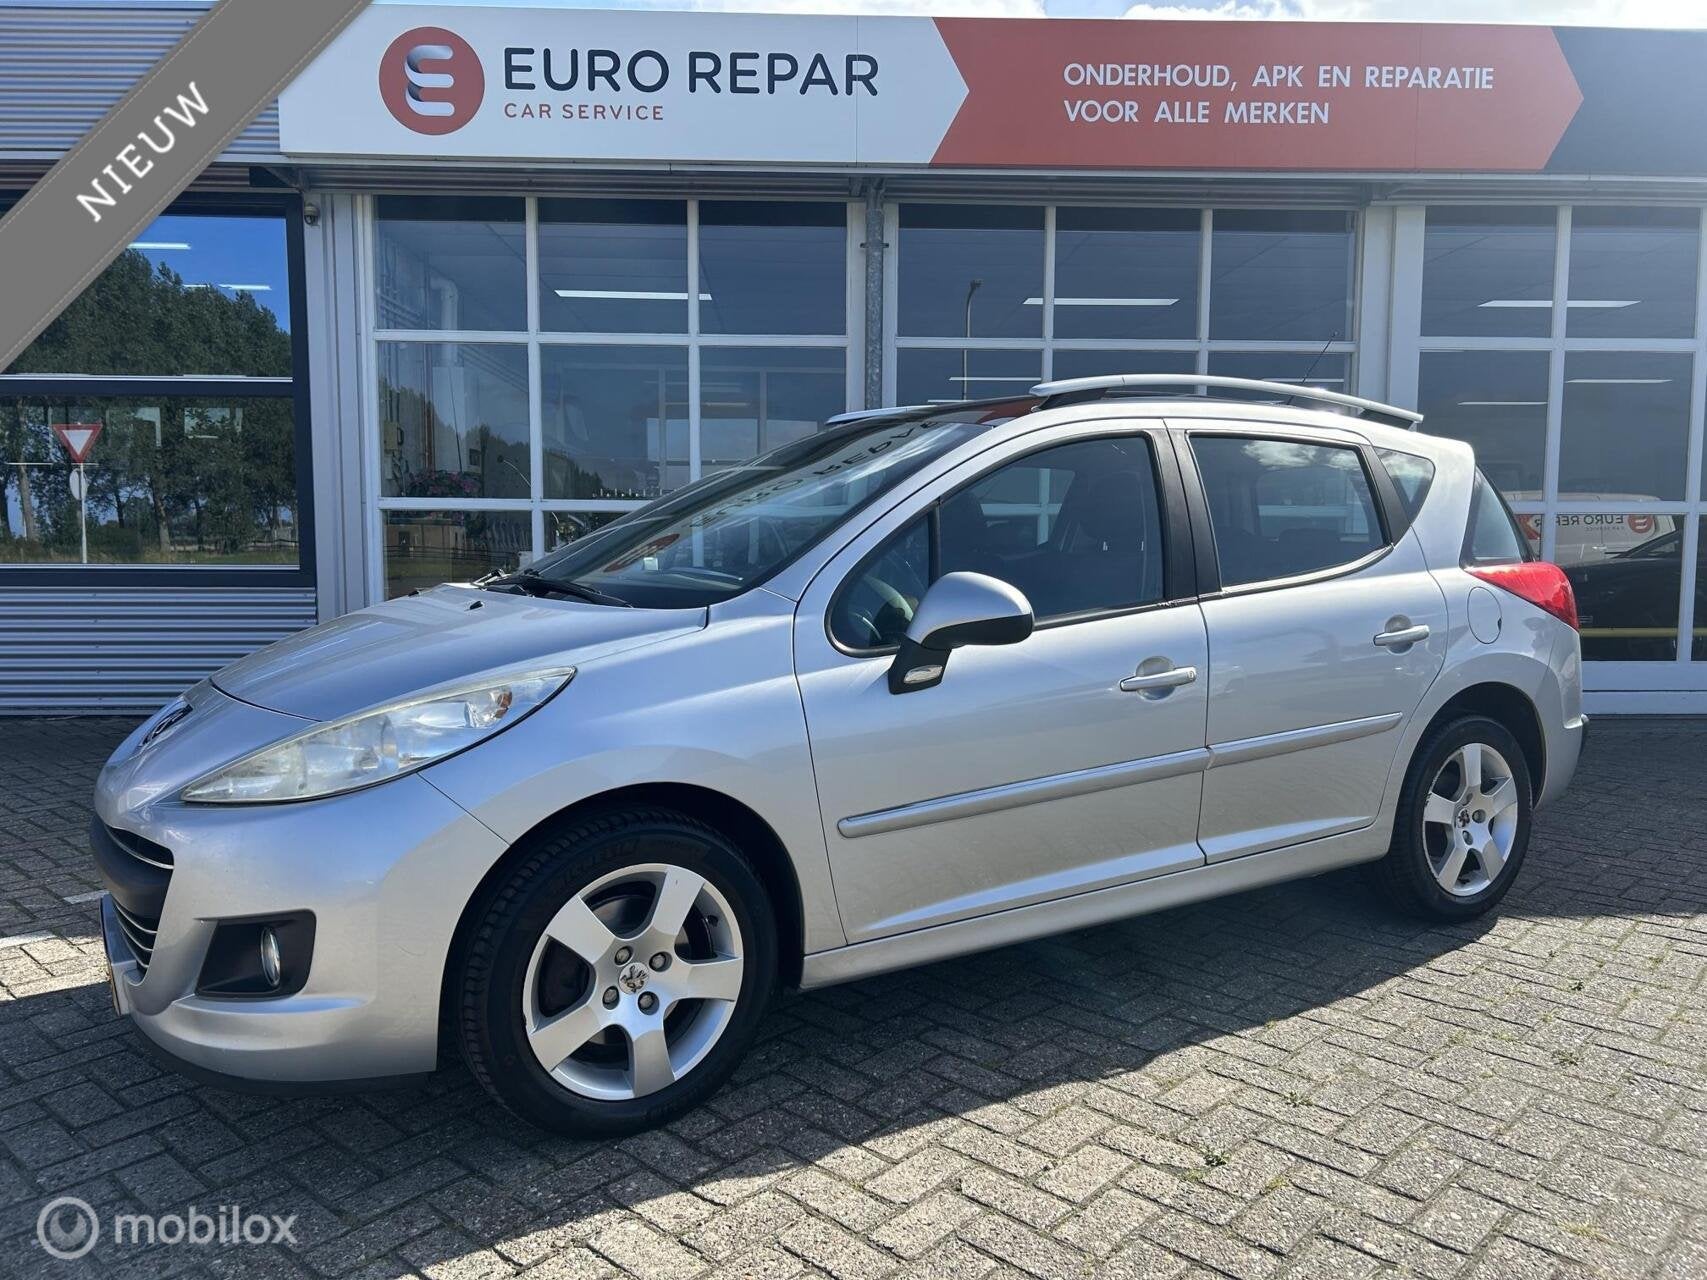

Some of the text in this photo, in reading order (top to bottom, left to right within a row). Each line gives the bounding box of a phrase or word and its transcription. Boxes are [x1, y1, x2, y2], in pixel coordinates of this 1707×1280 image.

[504, 47, 879, 97] EURO REPAR
[1063, 63, 1494, 92] ONDERHOUD, APK EN REPARATIE
[504, 102, 664, 121] CAR SERVICE
[1063, 100, 1329, 124] VOOR ALLE MERKEN
